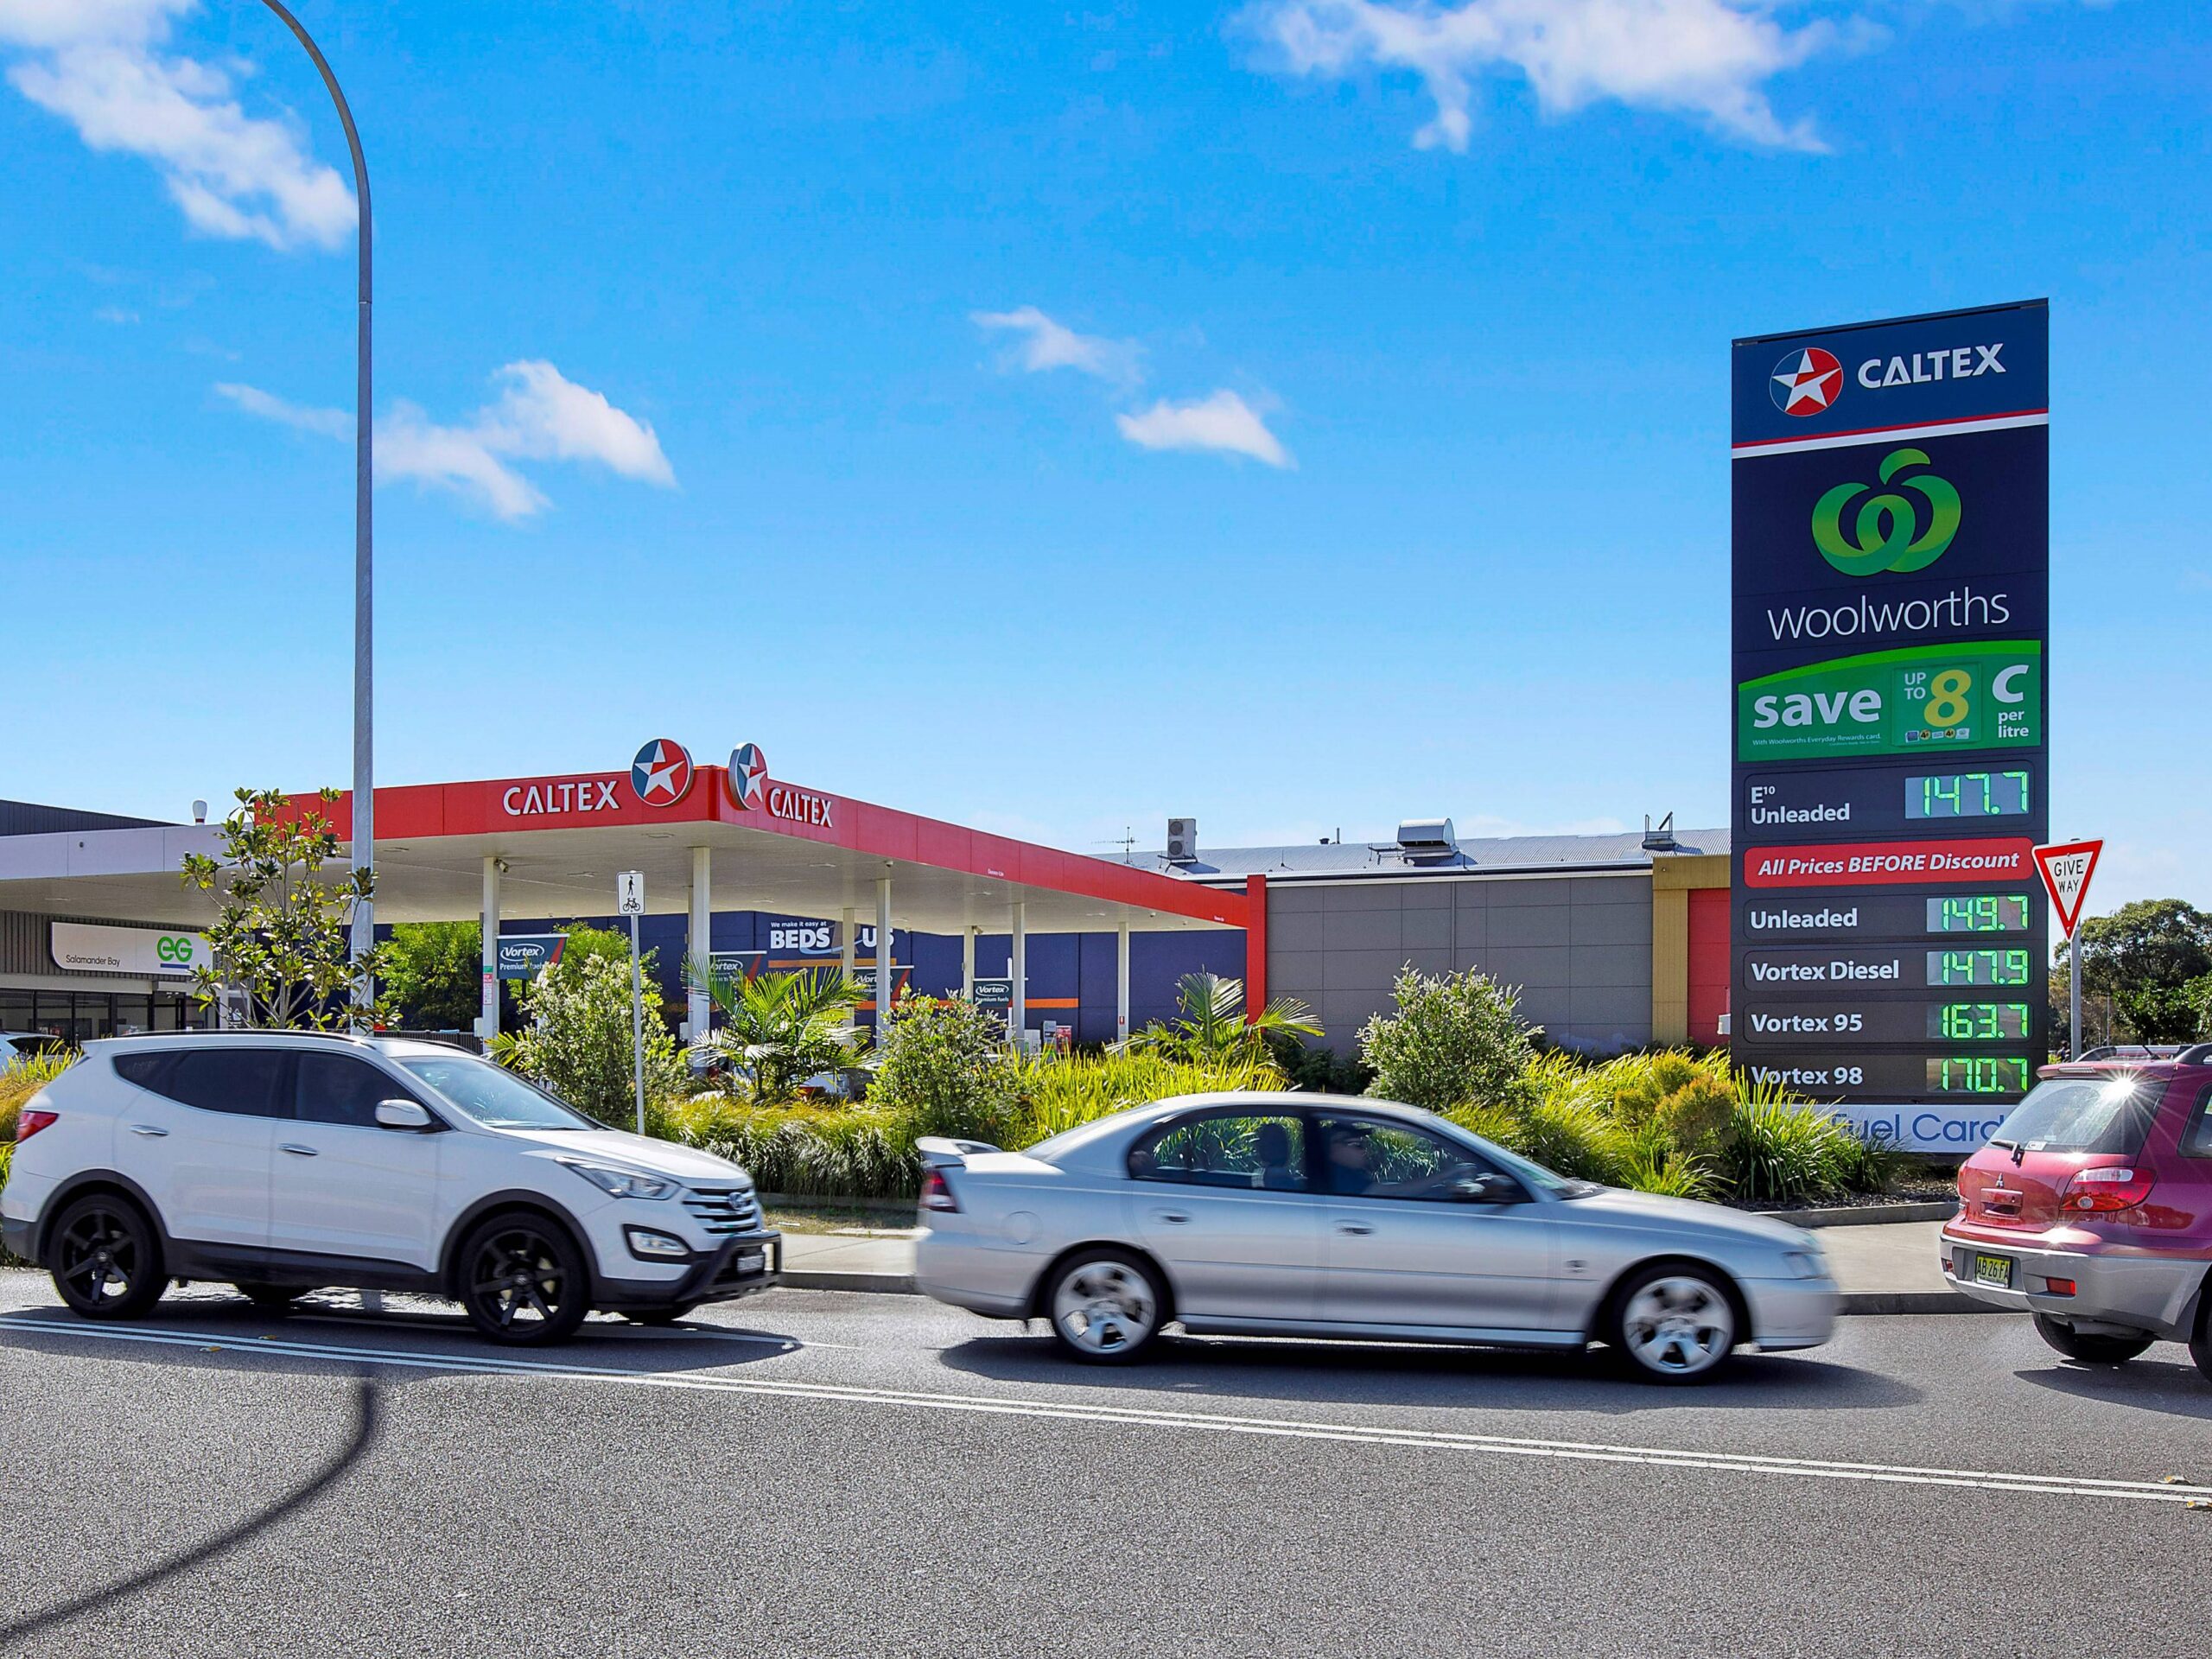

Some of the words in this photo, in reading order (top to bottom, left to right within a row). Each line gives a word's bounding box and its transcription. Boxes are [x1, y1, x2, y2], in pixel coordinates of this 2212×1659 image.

[1857, 343, 2007, 388] CALTEX
[1767, 586, 2010, 641] Woolworths
[1904, 671, 1927, 685] UP
[1904, 686, 1927, 700] TO
[1923, 669, 1972, 728] 8
[1752, 688, 1882, 729] save
[1998, 709, 2025, 725] per
[1998, 725, 2030, 739] litre
[503, 780, 620, 816] CALTEX
[1922, 771, 2029, 817] 147.7
[769, 787, 834, 829] CALTEX
[1751, 802, 1850, 824] Unleaded
[1758, 859, 1784, 876] All
[1787, 857, 1844, 874] Prices
[1847, 855, 1926, 874] BEFORE
[1929, 852, 2019, 870] Discount
[2054, 859, 2084, 877] GIVE
[2058, 879, 2080, 893] WAY
[1751, 907, 1858, 929] Unleaded
[1942, 895, 2029, 931] 149.7
[770, 927, 830, 950] BEDS
[66, 954, 106, 966] Salamander
[107, 956, 121, 967] Bay
[502, 946, 540, 957] Vortex
[1751, 962, 1826, 982] Vortex
[1830, 959, 1899, 981] Diesel
[1942, 950, 2029, 985] 147.9
[978, 986, 1006, 995] Vortex
[1751, 1013, 1827, 1033] Vortex
[1834, 1013, 1863, 1032] 95
[1942, 1002, 2029, 1039] 163.7
[1751, 1066, 1828, 1084] Vortex
[1834, 1066, 1863, 1085] 98
[1941, 1057, 2029, 1093] 170.7
